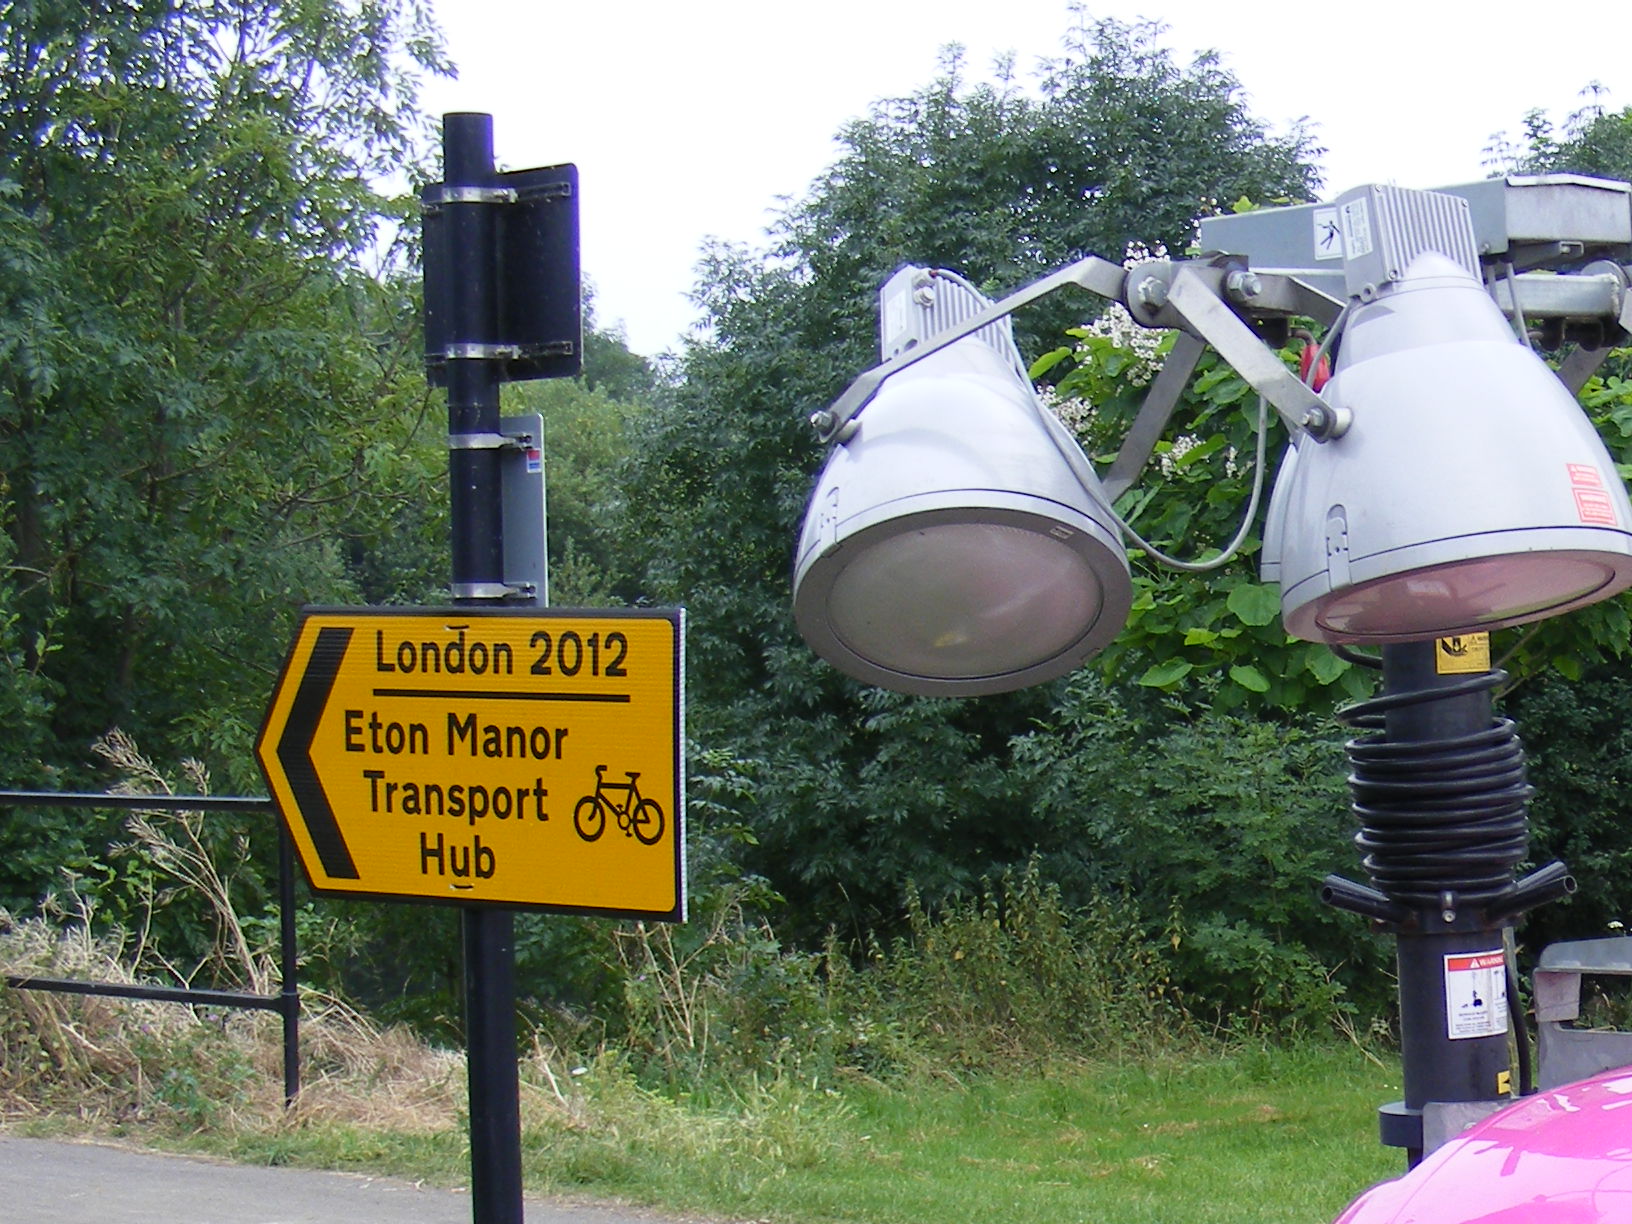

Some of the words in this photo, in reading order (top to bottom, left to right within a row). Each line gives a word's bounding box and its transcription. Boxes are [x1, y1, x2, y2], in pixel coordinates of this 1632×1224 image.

[376, 629, 513, 675] London
[529, 631, 628, 677] 2012
[344, 709, 429, 755] Eton
[447, 712, 569, 760] Manor
[363, 769, 550, 826] Transport
[420, 832, 496, 880] Hub
